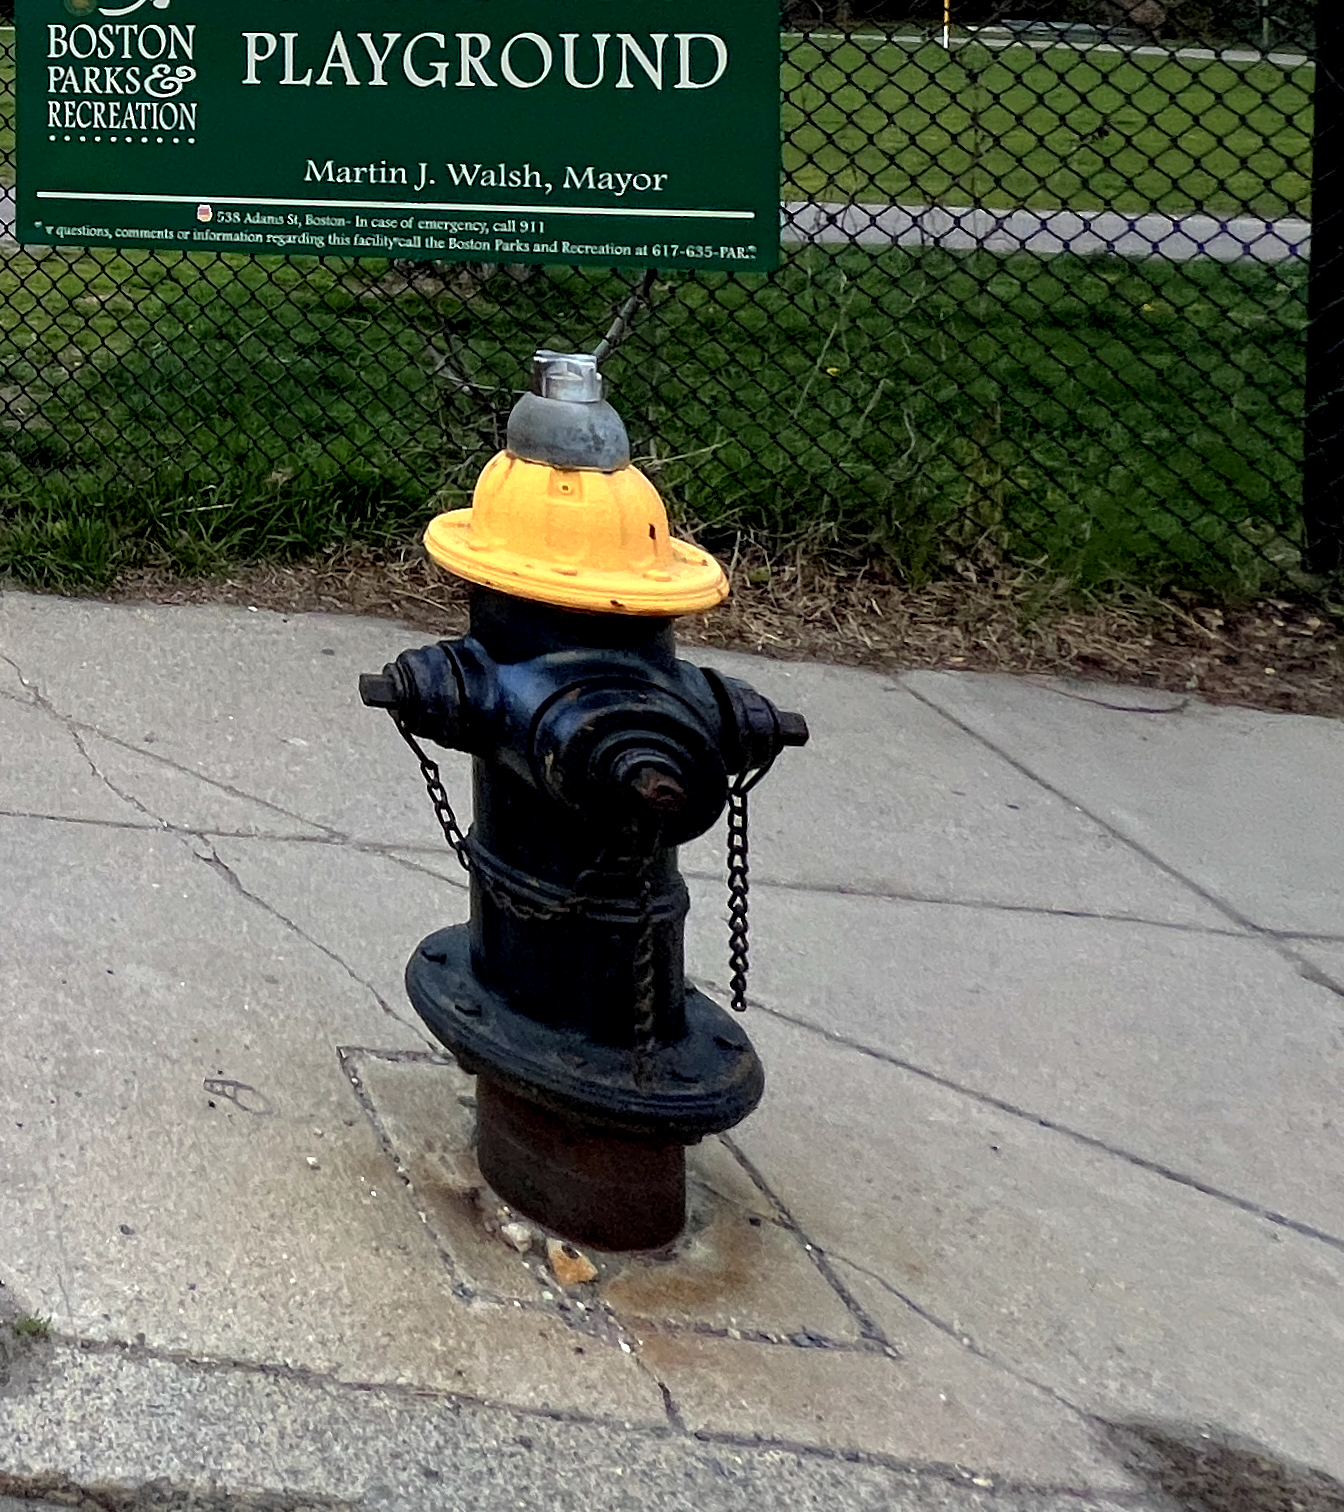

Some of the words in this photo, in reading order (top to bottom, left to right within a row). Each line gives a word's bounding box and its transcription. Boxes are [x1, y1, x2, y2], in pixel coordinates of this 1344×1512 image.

[47, 24, 195, 59] BOSTON
[242, 31, 727, 90] PLAYGROUND
[48, 66, 140, 94] PARKS
[48, 101, 197, 130] RECREATION
[304, 160, 407, 184] Martin
[414, 163, 435, 191] J.
[447, 164, 552, 194] Walsh,
[563, 167, 667, 196] Mayor
[217, 211, 240, 223] 538
[244, 212, 284, 224] Adams
[287, 214, 302, 228] St,
[356, 216, 368, 227] In
[371, 219, 397, 228] case
[400, 217, 414, 228] of
[418, 221, 489, 234] emergency,
[493, 220, 515, 232] call
[520, 221, 543, 233] 911
[56, 226, 112, 239] questions,
[115, 228, 174, 239] comments
[177, 231, 190, 239] or
[193, 229, 263, 242] information
[266, 232, 325, 248] regarding
[328, 233, 350, 245] this
[397, 236, 421, 248] call
[425, 236, 445, 248] the
[449, 238, 490, 250] Boston
[495, 239, 529, 252] Parks
[533, 241, 558, 252] and
[562, 241, 631, 255] Recreation
[635, 245, 648, 255] at
